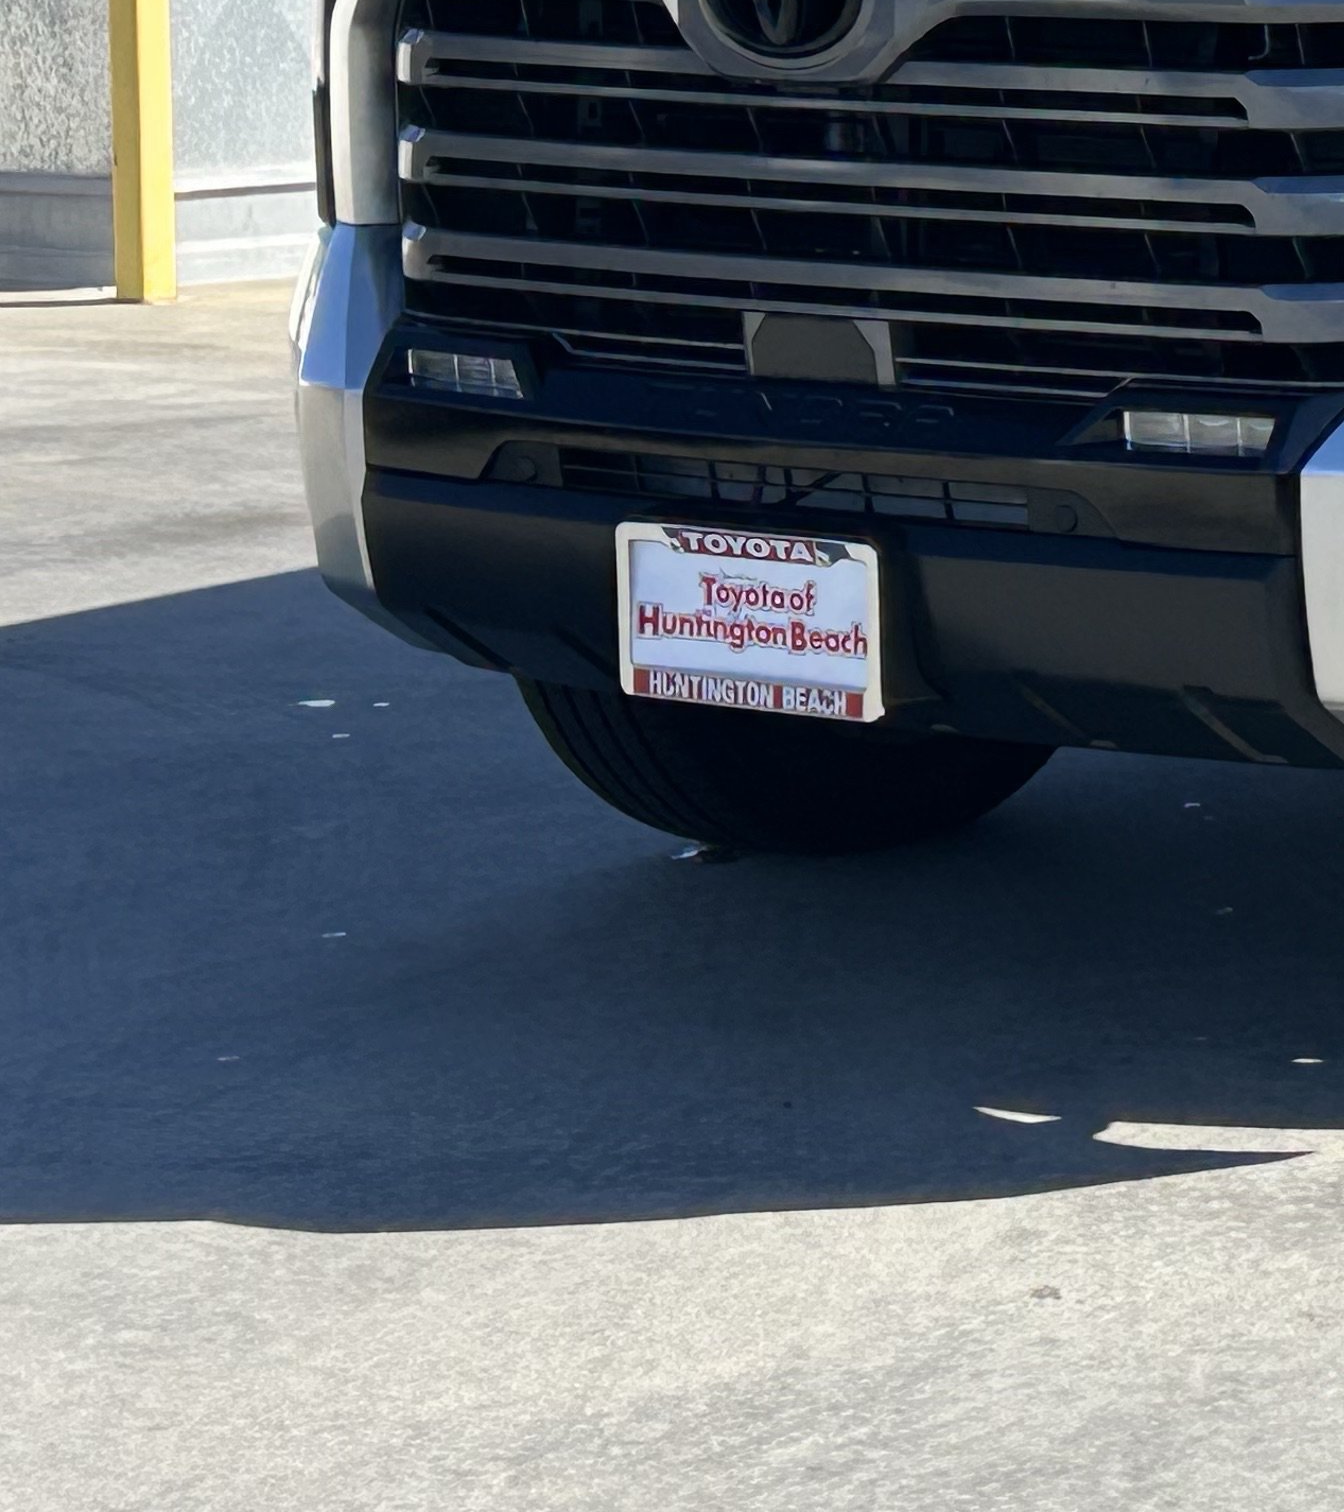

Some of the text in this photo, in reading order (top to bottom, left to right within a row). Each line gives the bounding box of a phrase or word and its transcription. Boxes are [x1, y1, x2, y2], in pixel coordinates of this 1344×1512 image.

[682, 531, 814, 563] TOYOTA
[700, 575, 815, 614] Toyota of
[638, 604, 868, 658] Huntington Beach
[648, 671, 847, 717] HUNTINGTON BEACH
